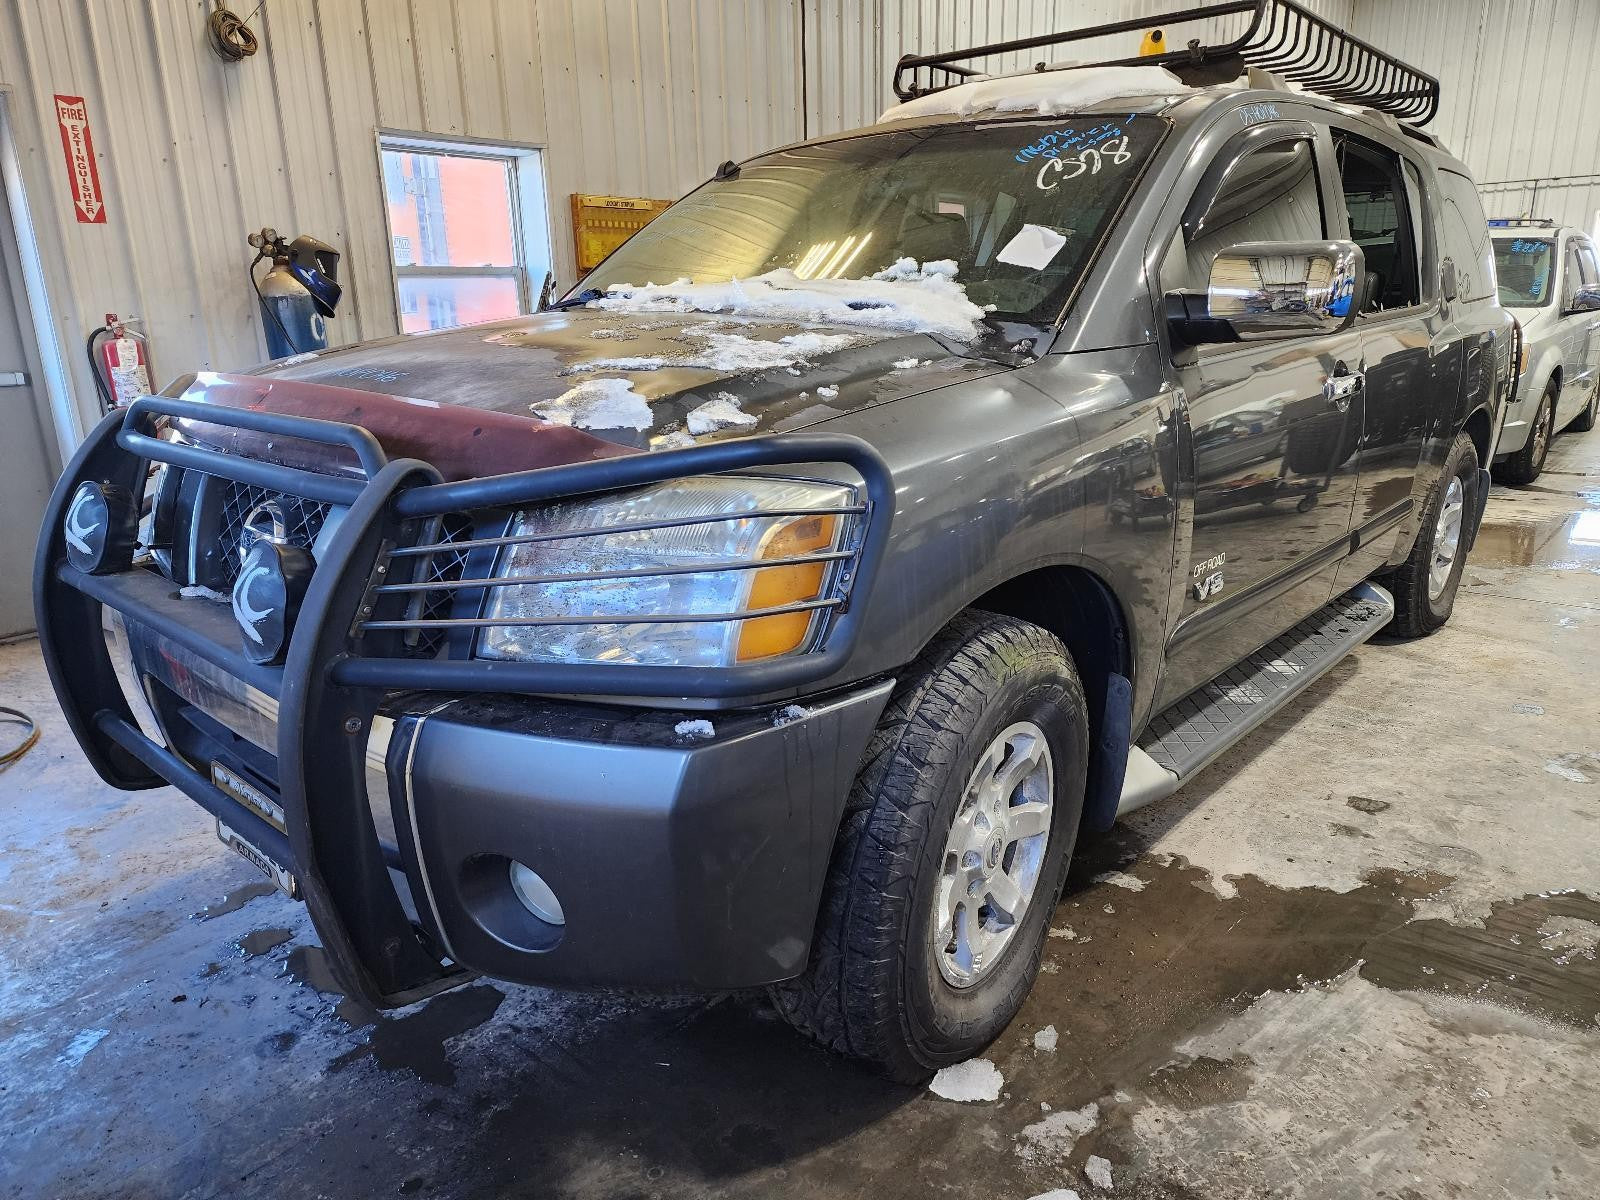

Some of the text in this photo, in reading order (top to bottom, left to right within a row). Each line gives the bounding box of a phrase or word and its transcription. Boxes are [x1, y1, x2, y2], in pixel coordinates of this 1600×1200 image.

[60, 107, 84, 121] FIRE
[71, 124, 95, 214] EXTINGUISHER
[1194, 551, 1226, 578] OFF ROAD
[238, 843, 272, 878] ARMADA
